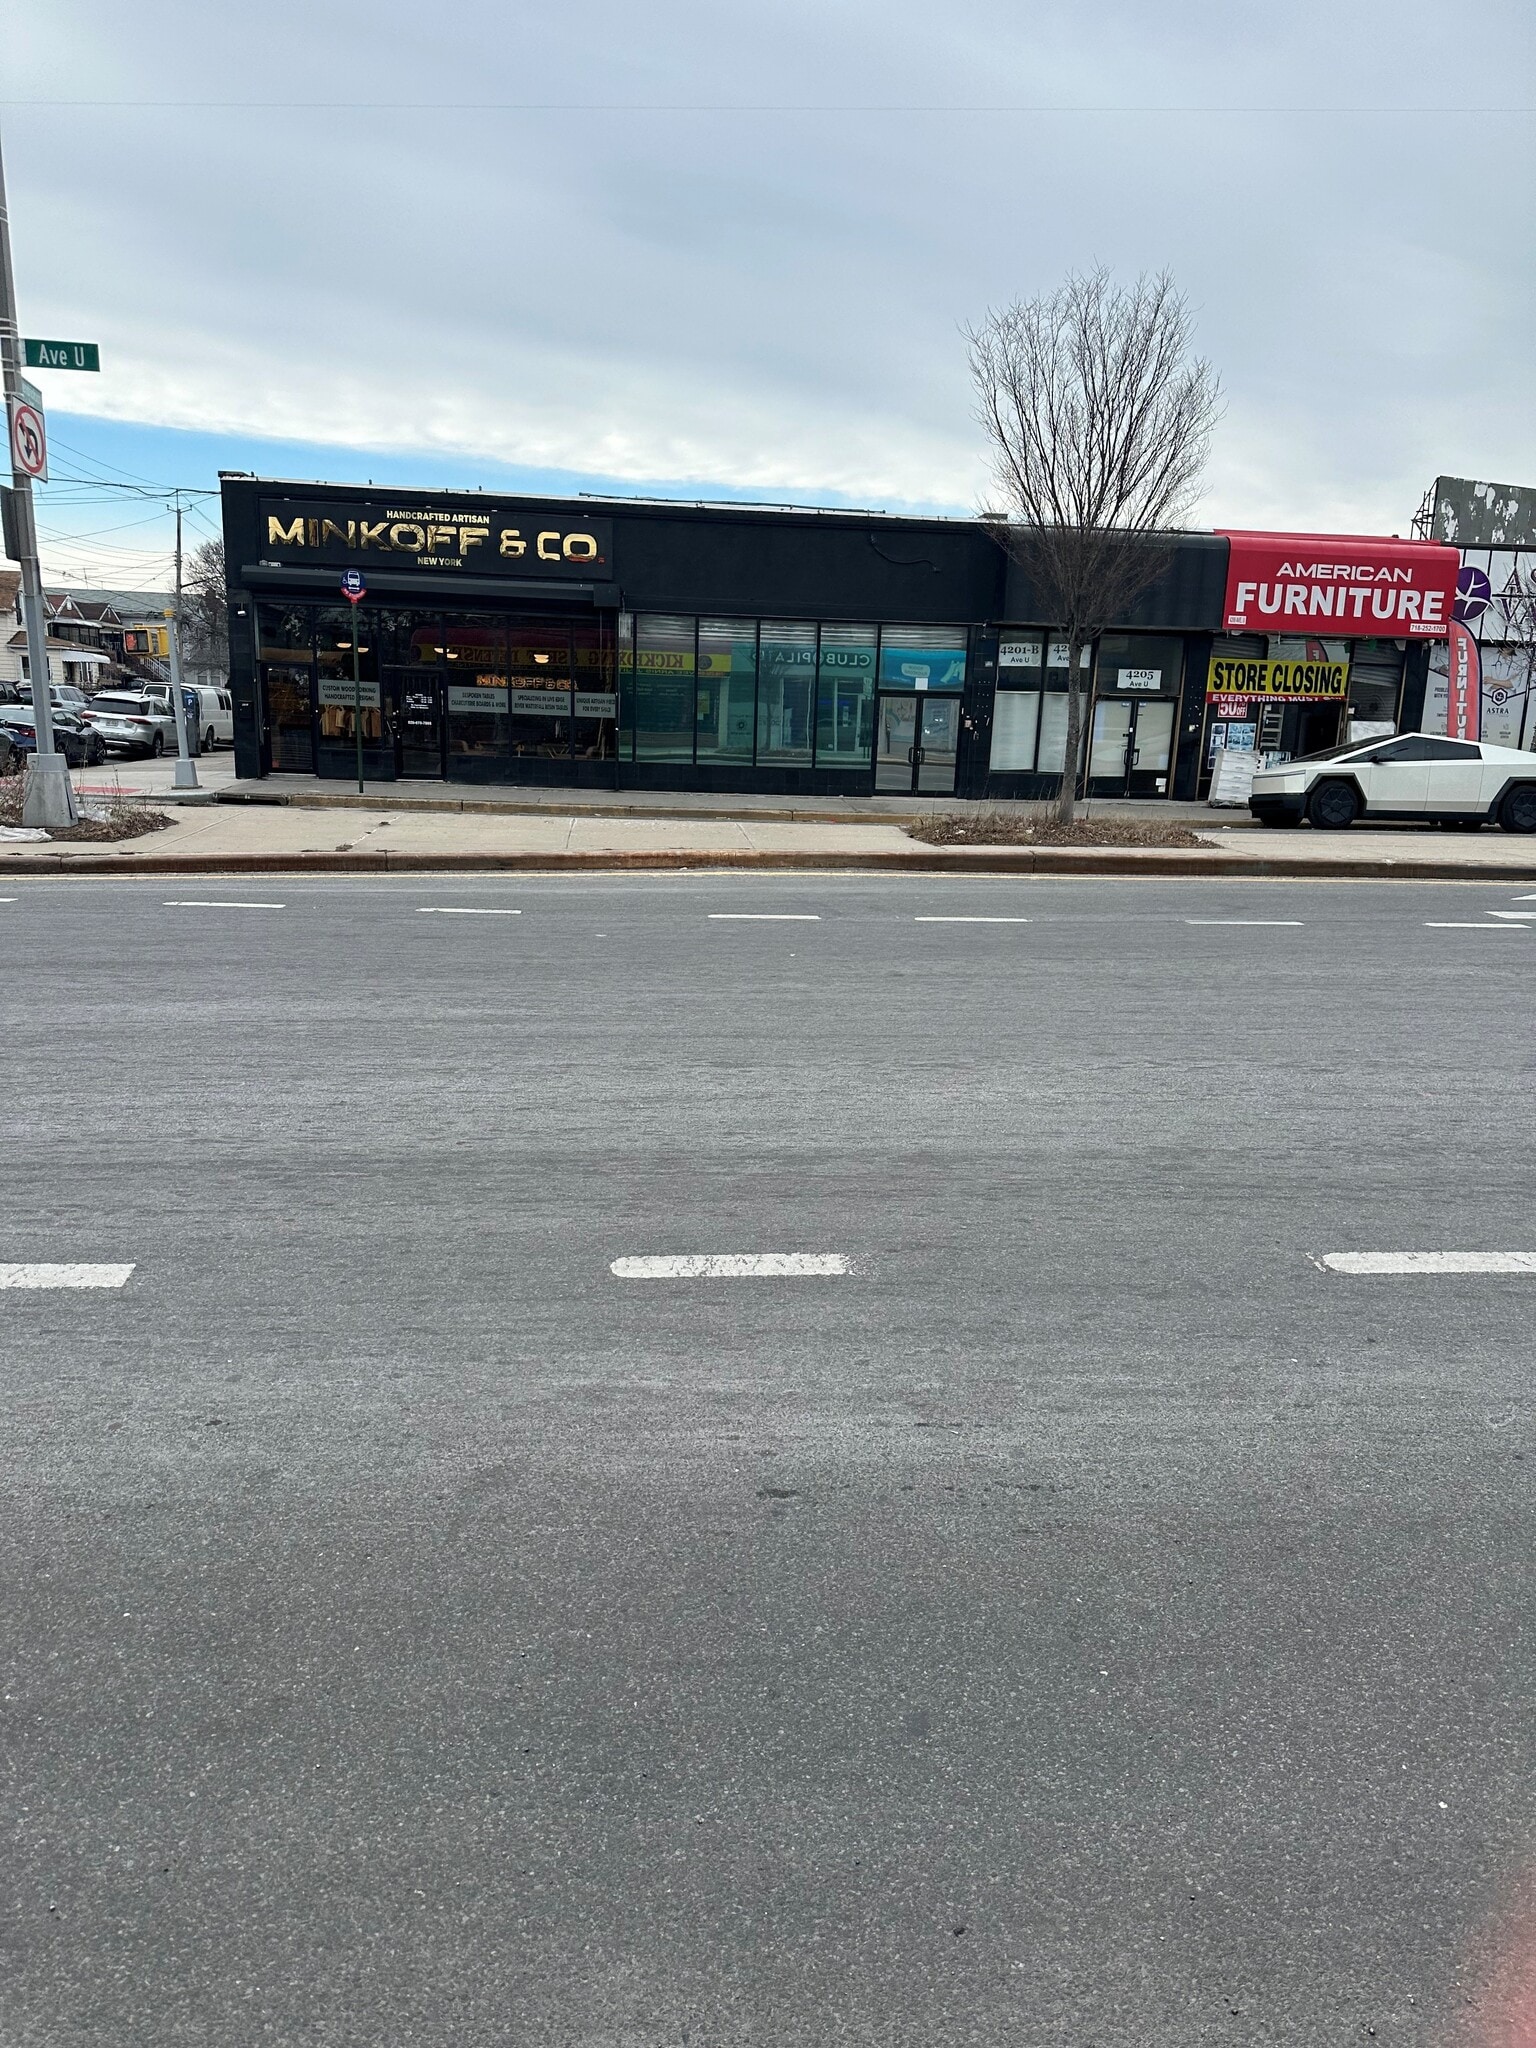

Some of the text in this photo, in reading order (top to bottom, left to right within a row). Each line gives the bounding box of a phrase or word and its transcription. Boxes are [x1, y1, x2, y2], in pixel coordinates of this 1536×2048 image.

[39, 343, 85, 367] Ave U
[386, 510, 490, 524] HANDCRAFTED ARTISAN
[268, 516, 490, 556] MINKOFF
[500, 529, 527, 559] &
[417, 556, 463, 567] NEW YORK
[1276, 562, 1413, 583] AMERICAN
[1235, 582, 1445, 621] FURNITURE
[1000, 643, 1039, 656] 4201-B
[1126, 670, 1154, 680] 4205
[1213, 661, 1343, 694] STORE CLOSING
[1212, 694, 1286, 703] EVERYTHING
[1486, 707, 1509, 715] ASTRA
